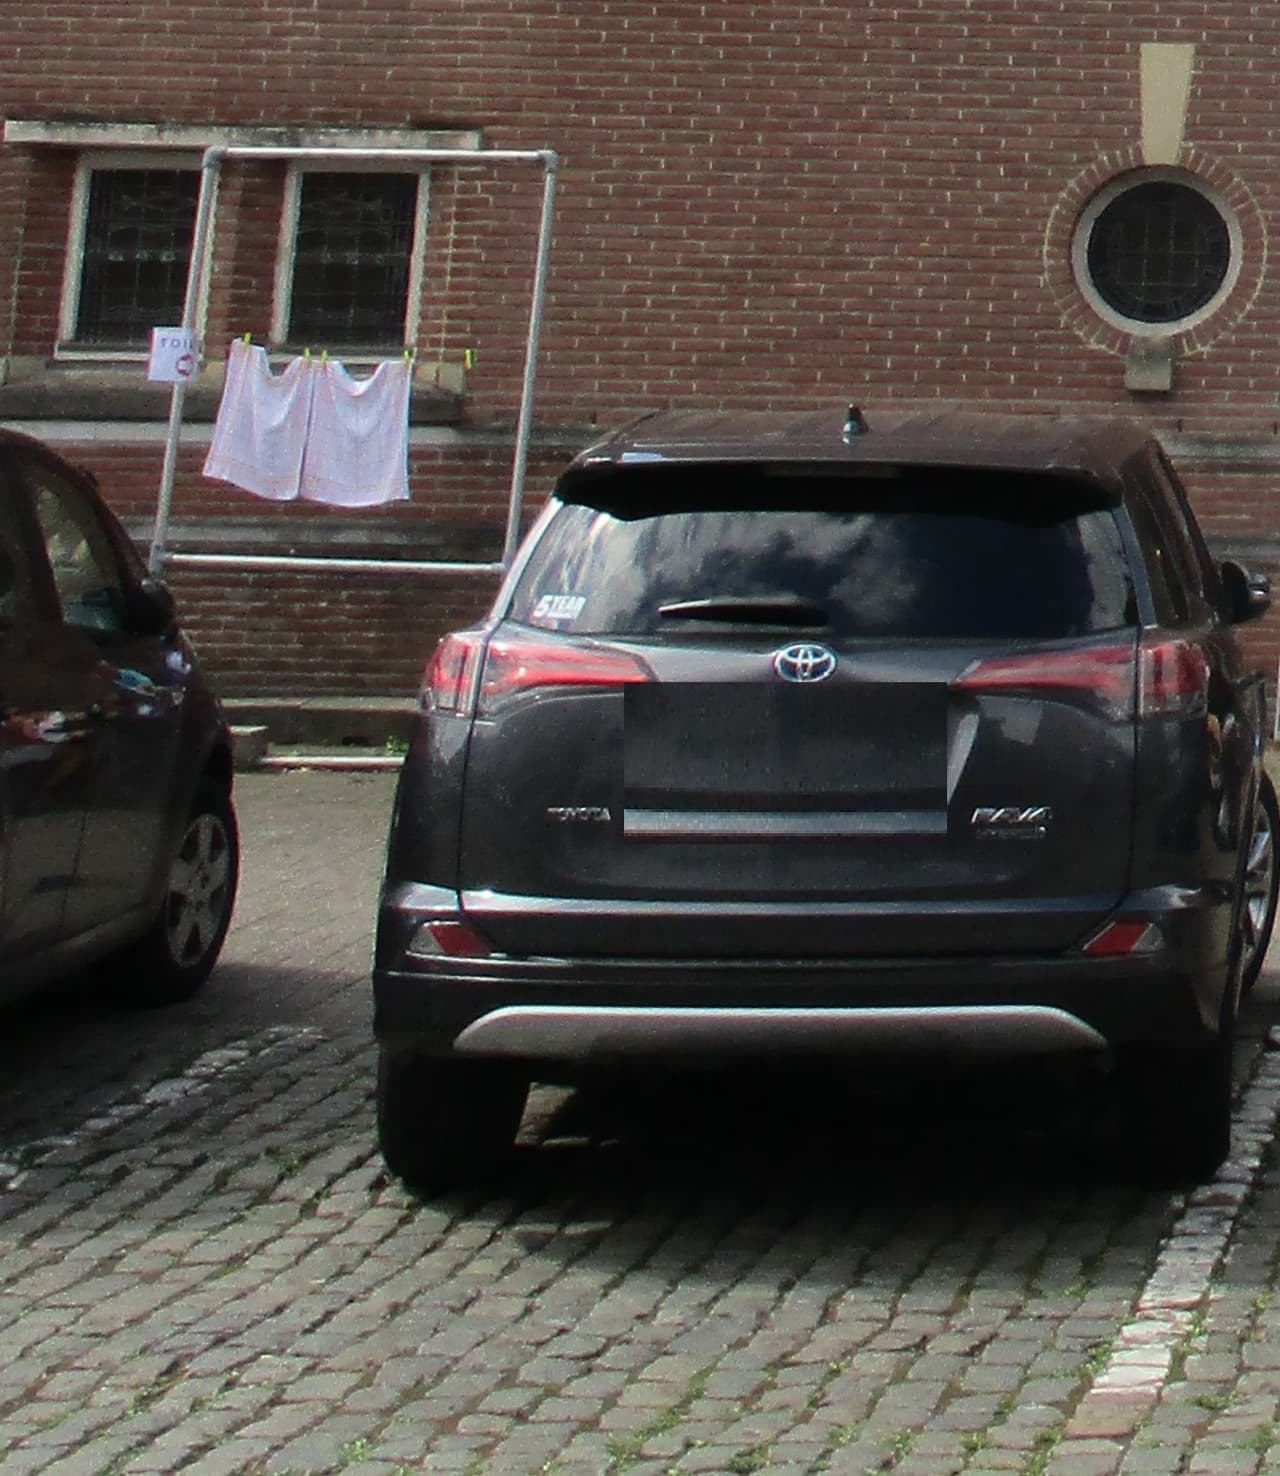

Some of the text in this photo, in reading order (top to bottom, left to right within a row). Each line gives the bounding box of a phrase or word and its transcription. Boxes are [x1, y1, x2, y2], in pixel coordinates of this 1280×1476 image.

[533, 594, 554, 617] 5
[549, 594, 586, 612] YEAR
[546, 806, 611, 822] TOYOTA
